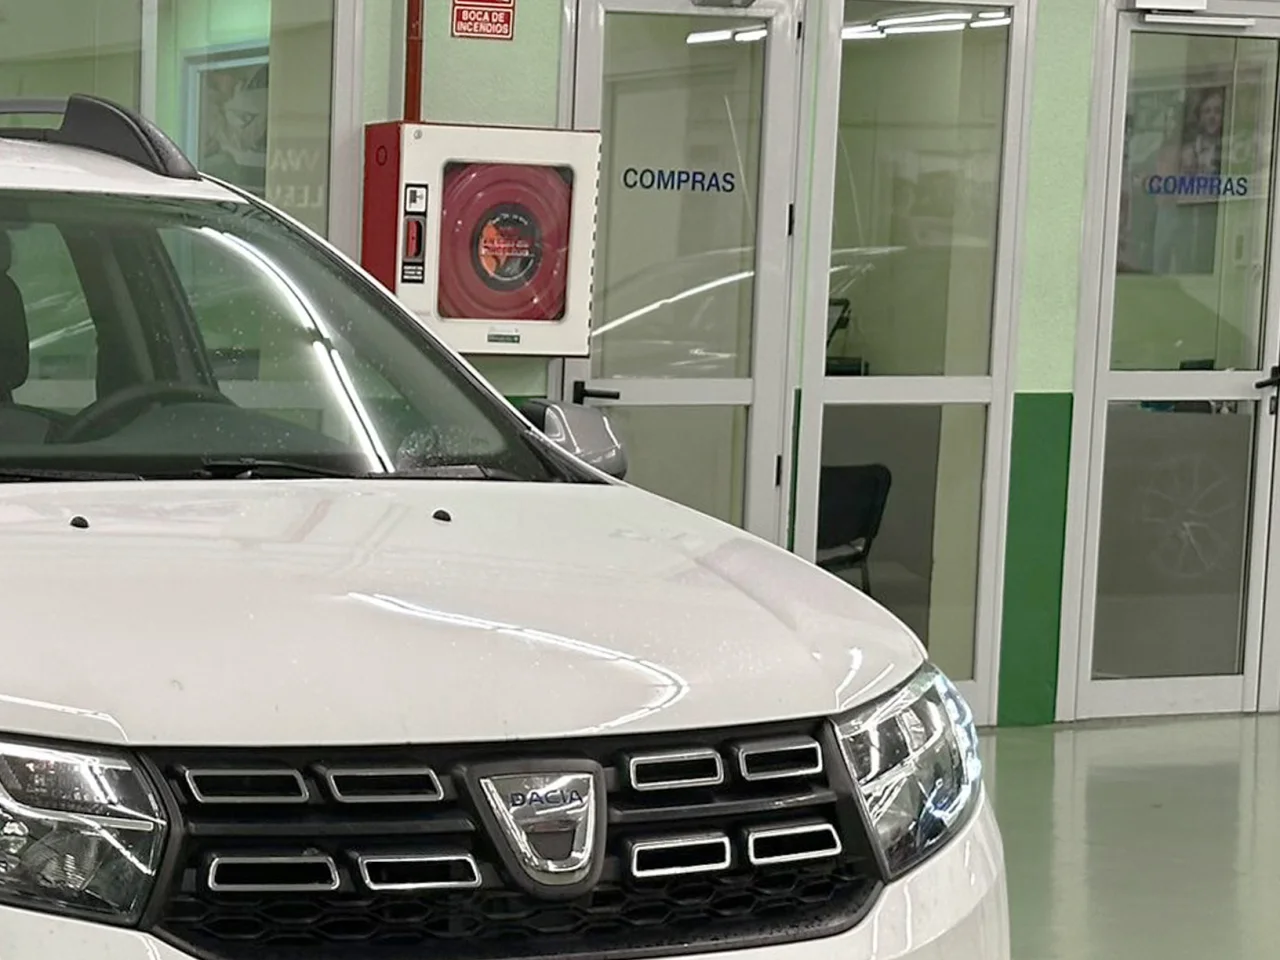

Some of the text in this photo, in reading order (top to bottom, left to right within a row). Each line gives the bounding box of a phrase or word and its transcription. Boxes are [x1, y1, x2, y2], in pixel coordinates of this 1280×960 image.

[462, 10, 505, 23] BOCA DE
[457, 21, 508, 34] INCENDIOS
[623, 168, 735, 193] COMPRAS
[1148, 174, 1249, 197] COMPRAS
[510, 789, 584, 807] DACIA
